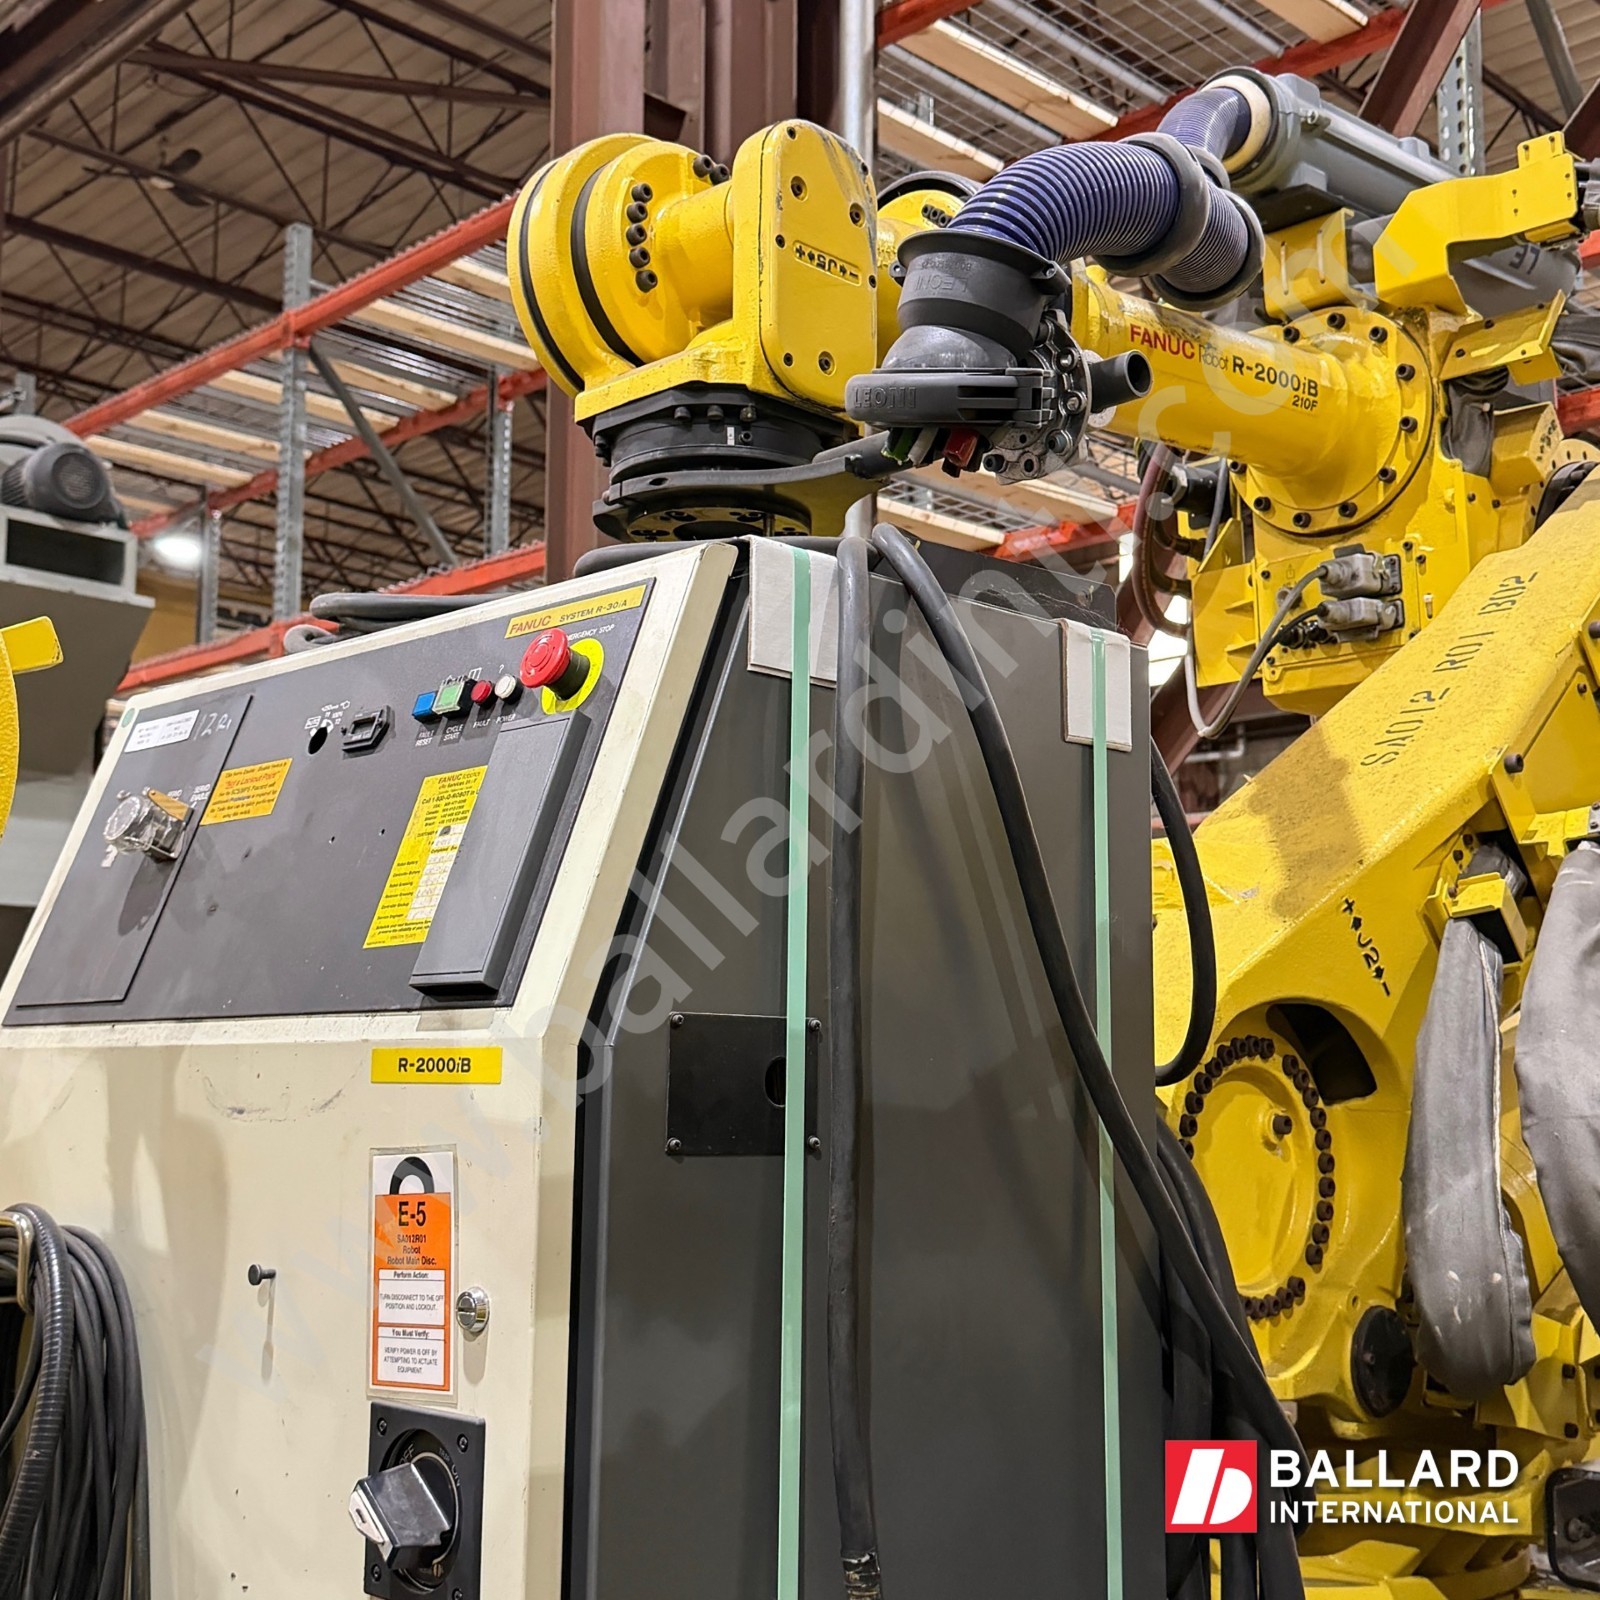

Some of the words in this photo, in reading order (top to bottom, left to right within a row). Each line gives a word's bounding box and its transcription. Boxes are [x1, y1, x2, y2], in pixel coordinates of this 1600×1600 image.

[1130, 324, 1195, 359] FANUC
[1199, 343, 1229, 371] Robot
[1233, 355, 1318, 397] R-2000iB
[1292, 395, 1318, 411] 210F
[509, 615, 551, 634] FANUC
[560, 607, 594, 622] SYSTEM
[599, 623, 615, 634] STOP
[438, 774, 463, 785] FANUC
[398, 1057, 471, 1073] R-2000iB
[398, 1200, 426, 1227] E-5
[402, 1245, 421, 1255] Robot
[387, 1256, 405, 1265] Robot
[406, 1256, 420, 1265] Main
[421, 1256, 437, 1266] Disc.
[393, 1271, 412, 1279] Perform
[392, 1329, 401, 1337] You
